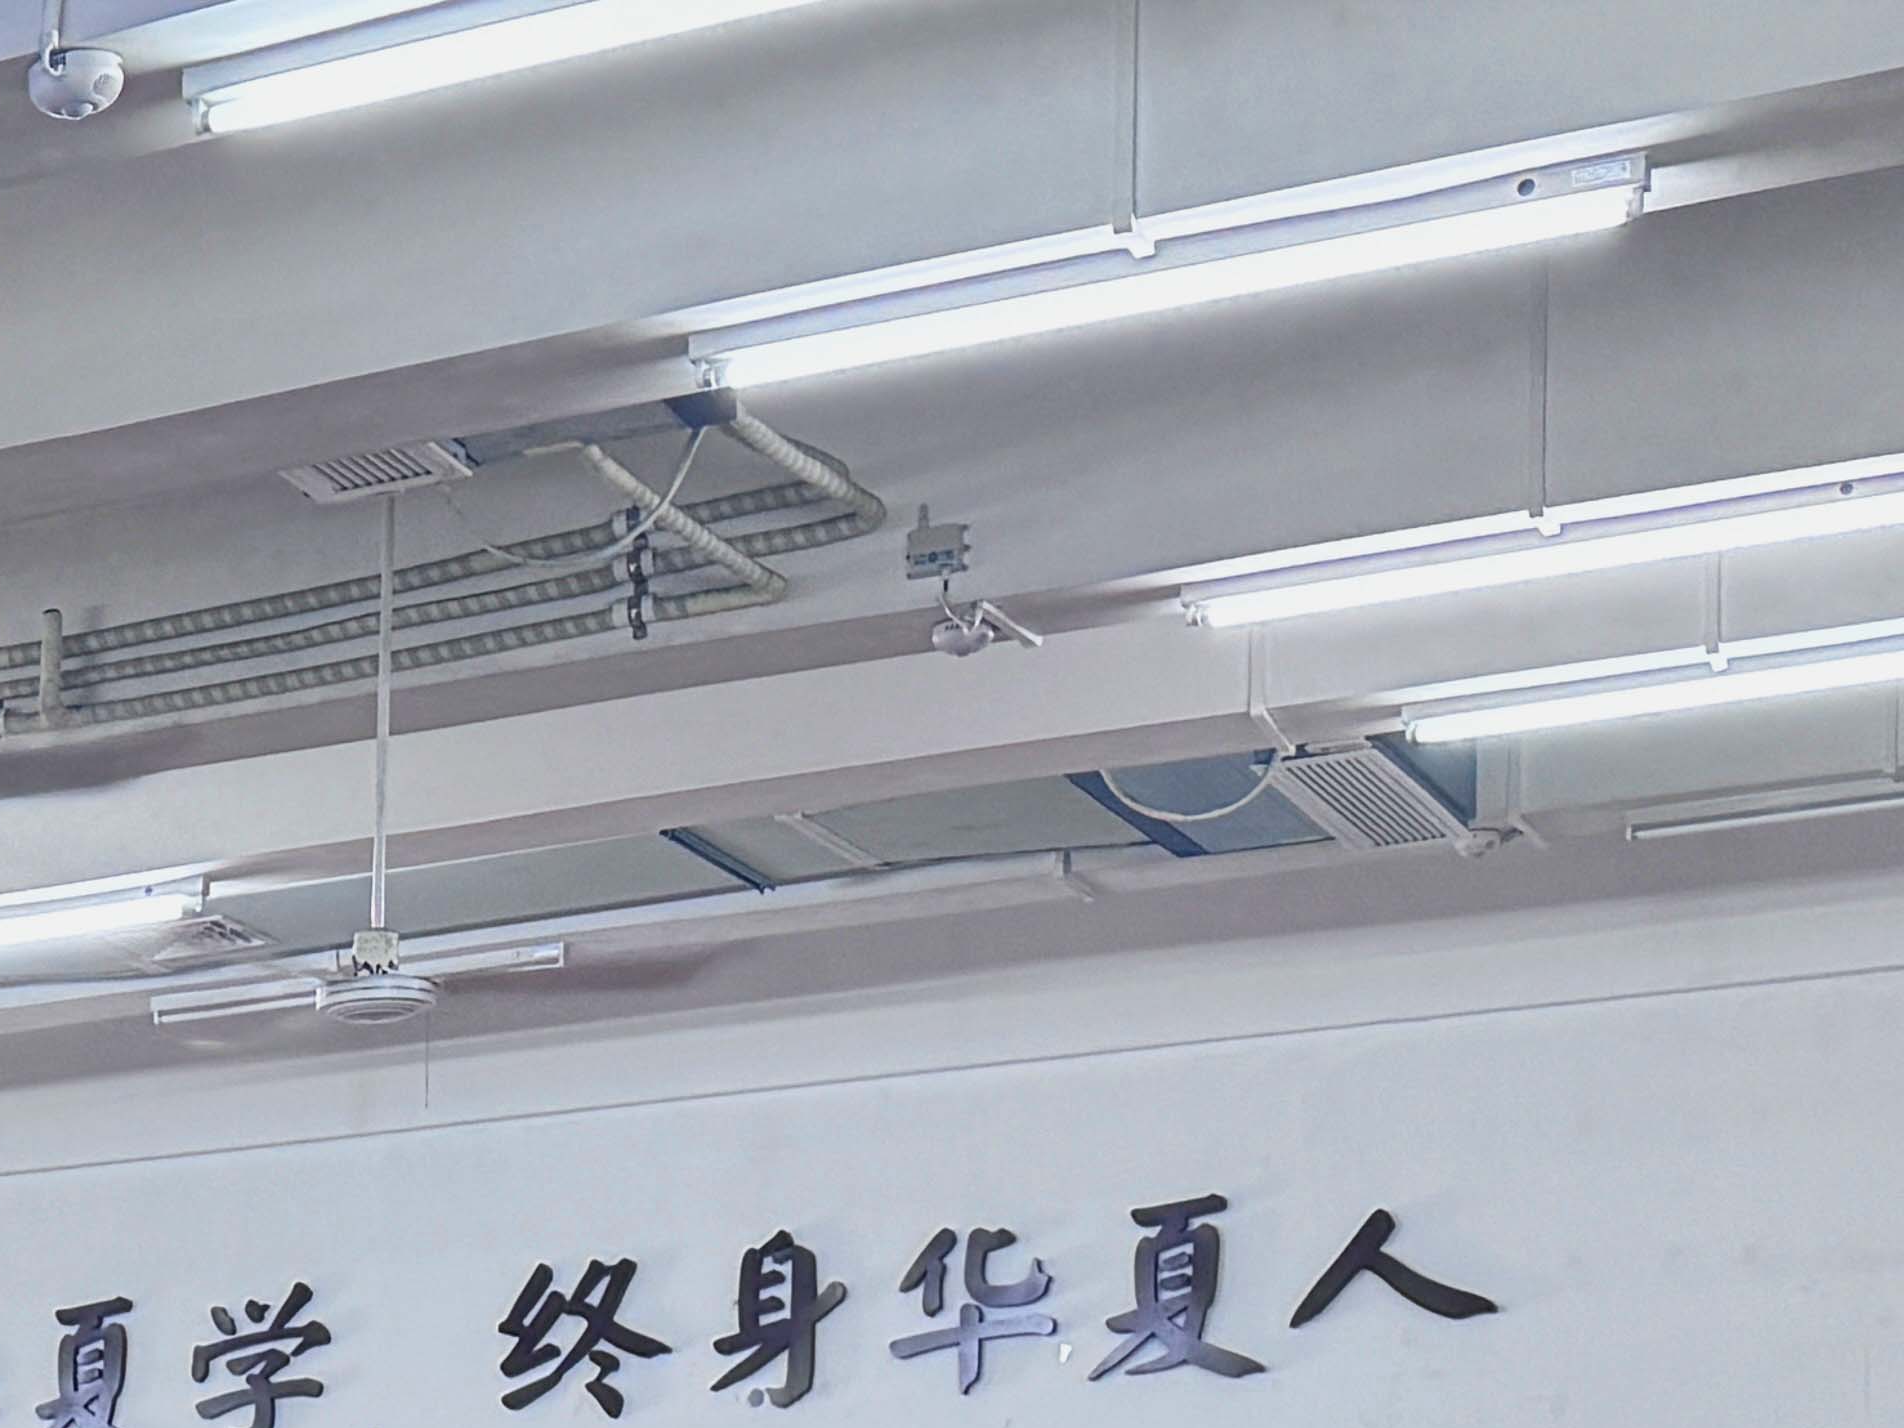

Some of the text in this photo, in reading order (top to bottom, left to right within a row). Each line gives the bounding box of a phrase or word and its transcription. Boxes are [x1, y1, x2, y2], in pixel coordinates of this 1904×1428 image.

[498, 1193, 1499, 1419] 终身华夏人
